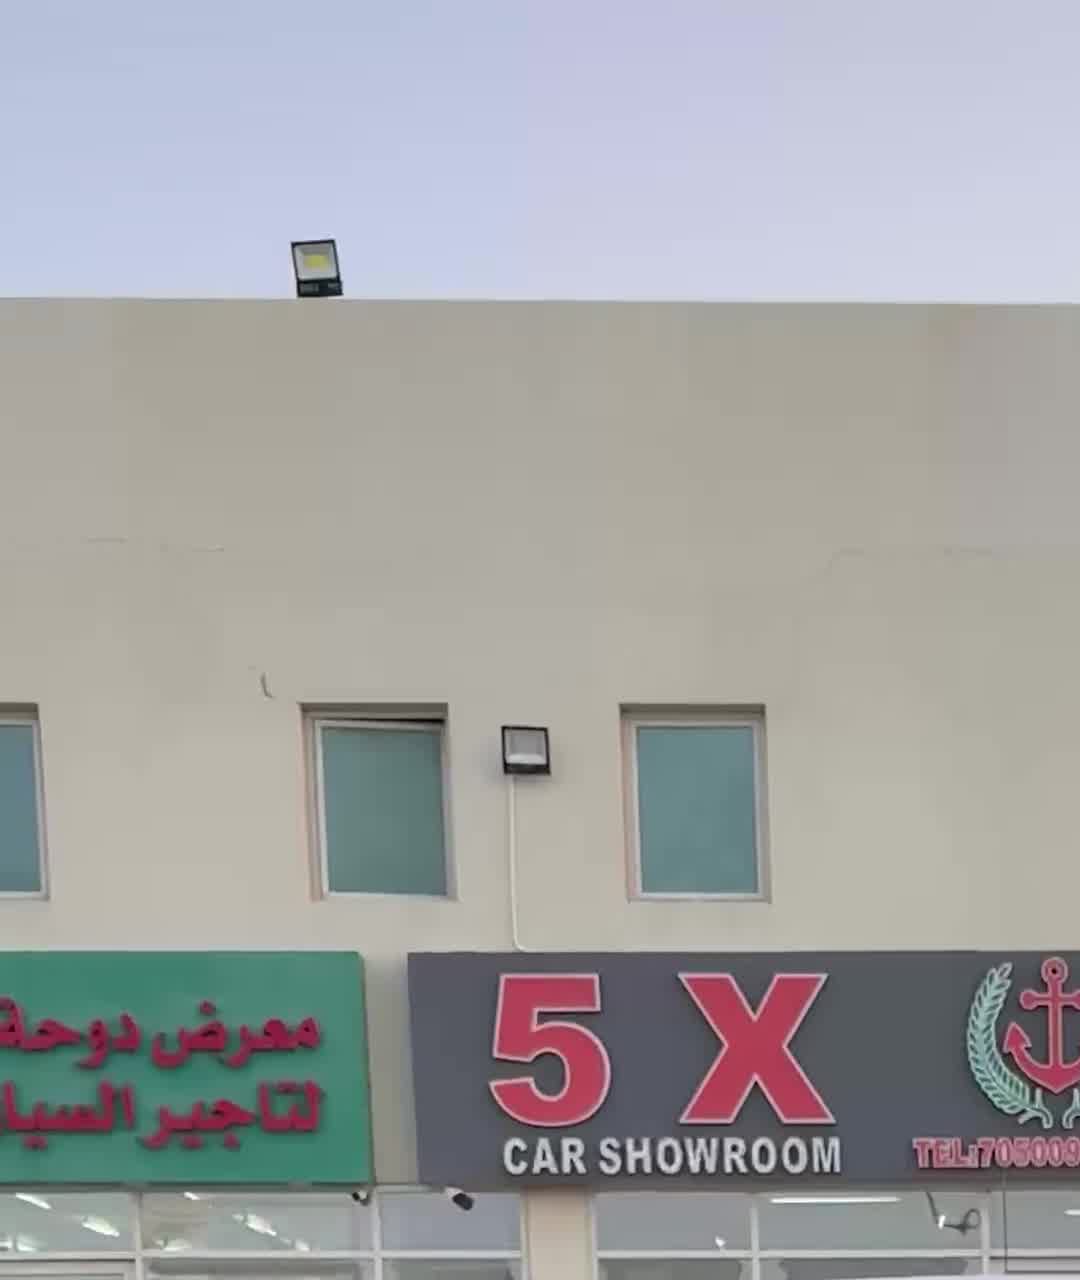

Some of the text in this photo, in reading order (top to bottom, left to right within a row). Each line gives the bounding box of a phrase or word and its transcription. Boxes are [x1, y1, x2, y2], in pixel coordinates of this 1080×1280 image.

[153, 1000, 322, 1069] معرض
[489, 973, 837, 1127] 5 X
[0, 1080, 134, 1150] السيا
[503, 1137, 842, 1175] CAR SHOWROOM
